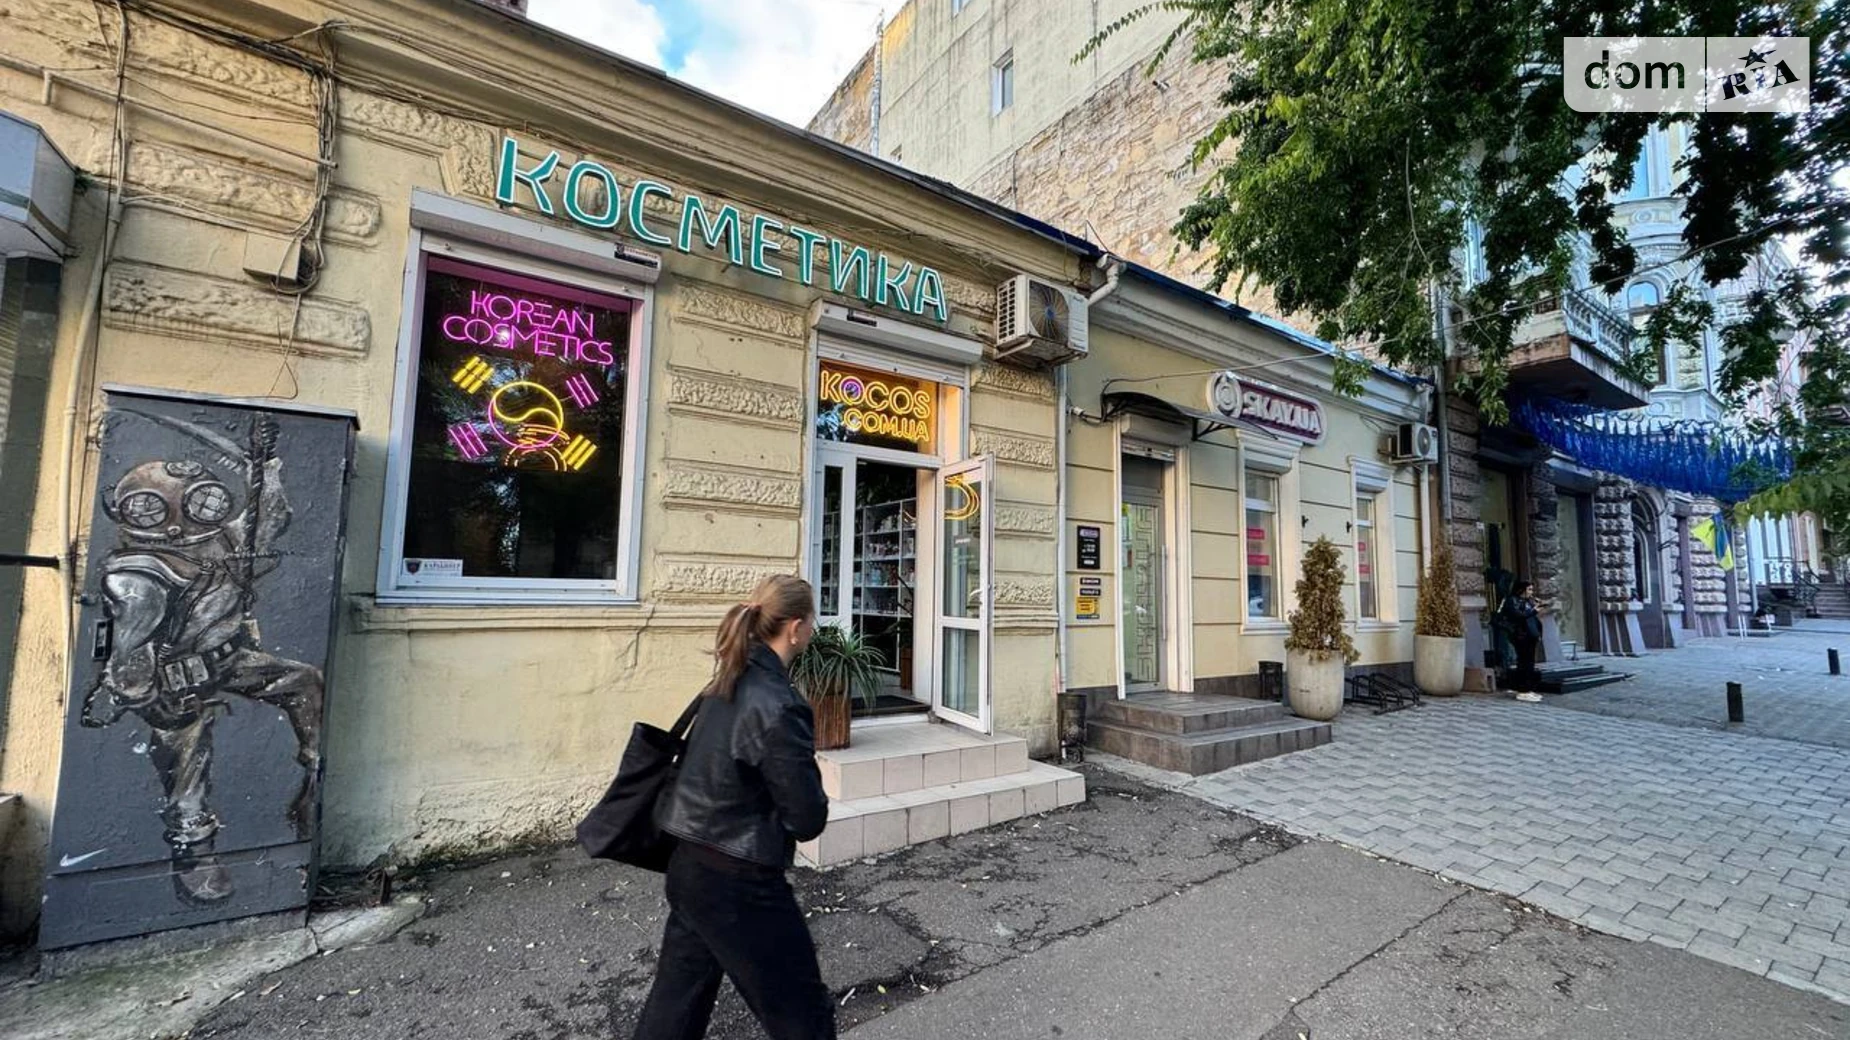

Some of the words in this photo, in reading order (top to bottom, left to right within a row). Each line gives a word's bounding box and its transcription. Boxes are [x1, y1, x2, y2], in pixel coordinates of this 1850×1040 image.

[496, 136, 948, 321] КОСМЕТИКА
[470, 290, 594, 338] KOREAN
[443, 315, 614, 366] COSMETICS
[820, 370, 930, 419] KOCOS
[843, 408, 930, 442] COM.UA
